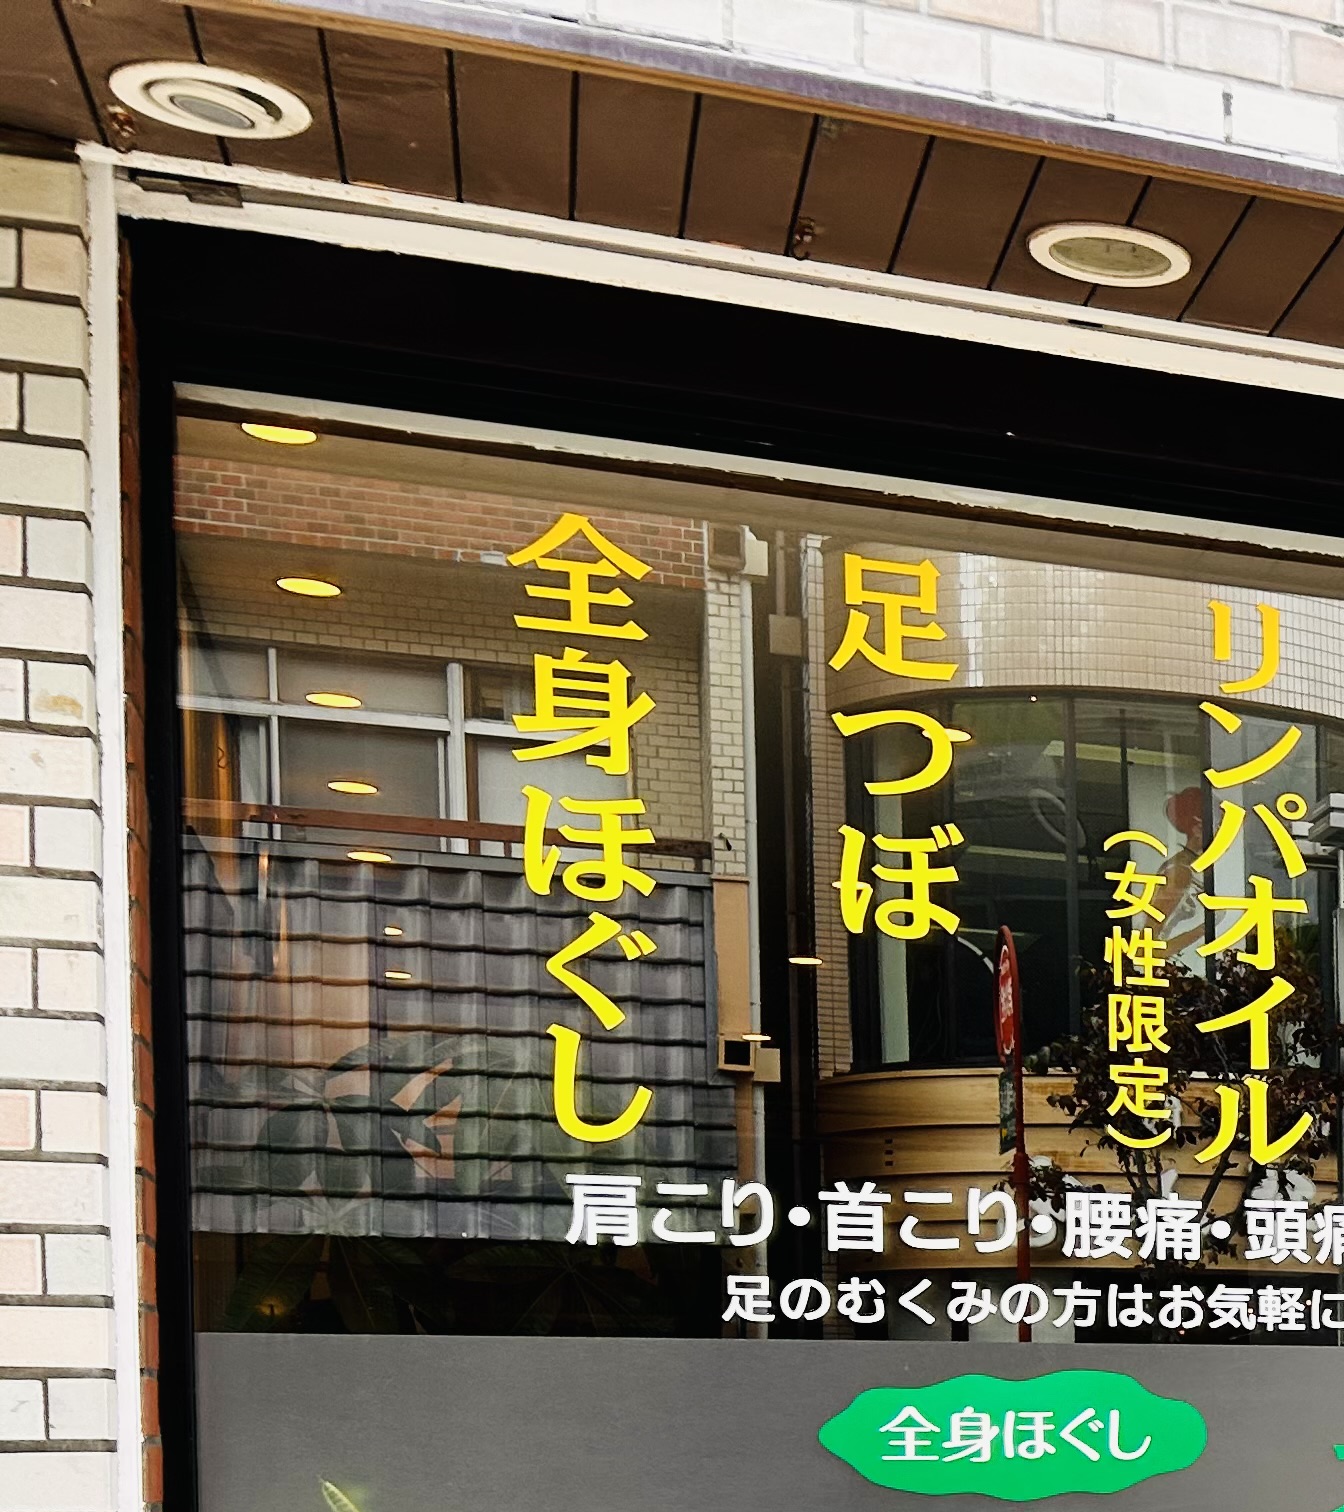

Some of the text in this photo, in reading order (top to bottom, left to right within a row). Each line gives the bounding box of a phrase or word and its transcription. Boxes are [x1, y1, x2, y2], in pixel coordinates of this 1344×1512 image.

[507, 512, 657, 1143] 全身ほぐし
[829, 552, 965, 940] 足つぼ
[1190, 600, 1314, 1166] リンパオイル
[1102, 830, 1172, 1153] (女性限定)
[879, 1406, 1152, 1464] 全身ほぐし
